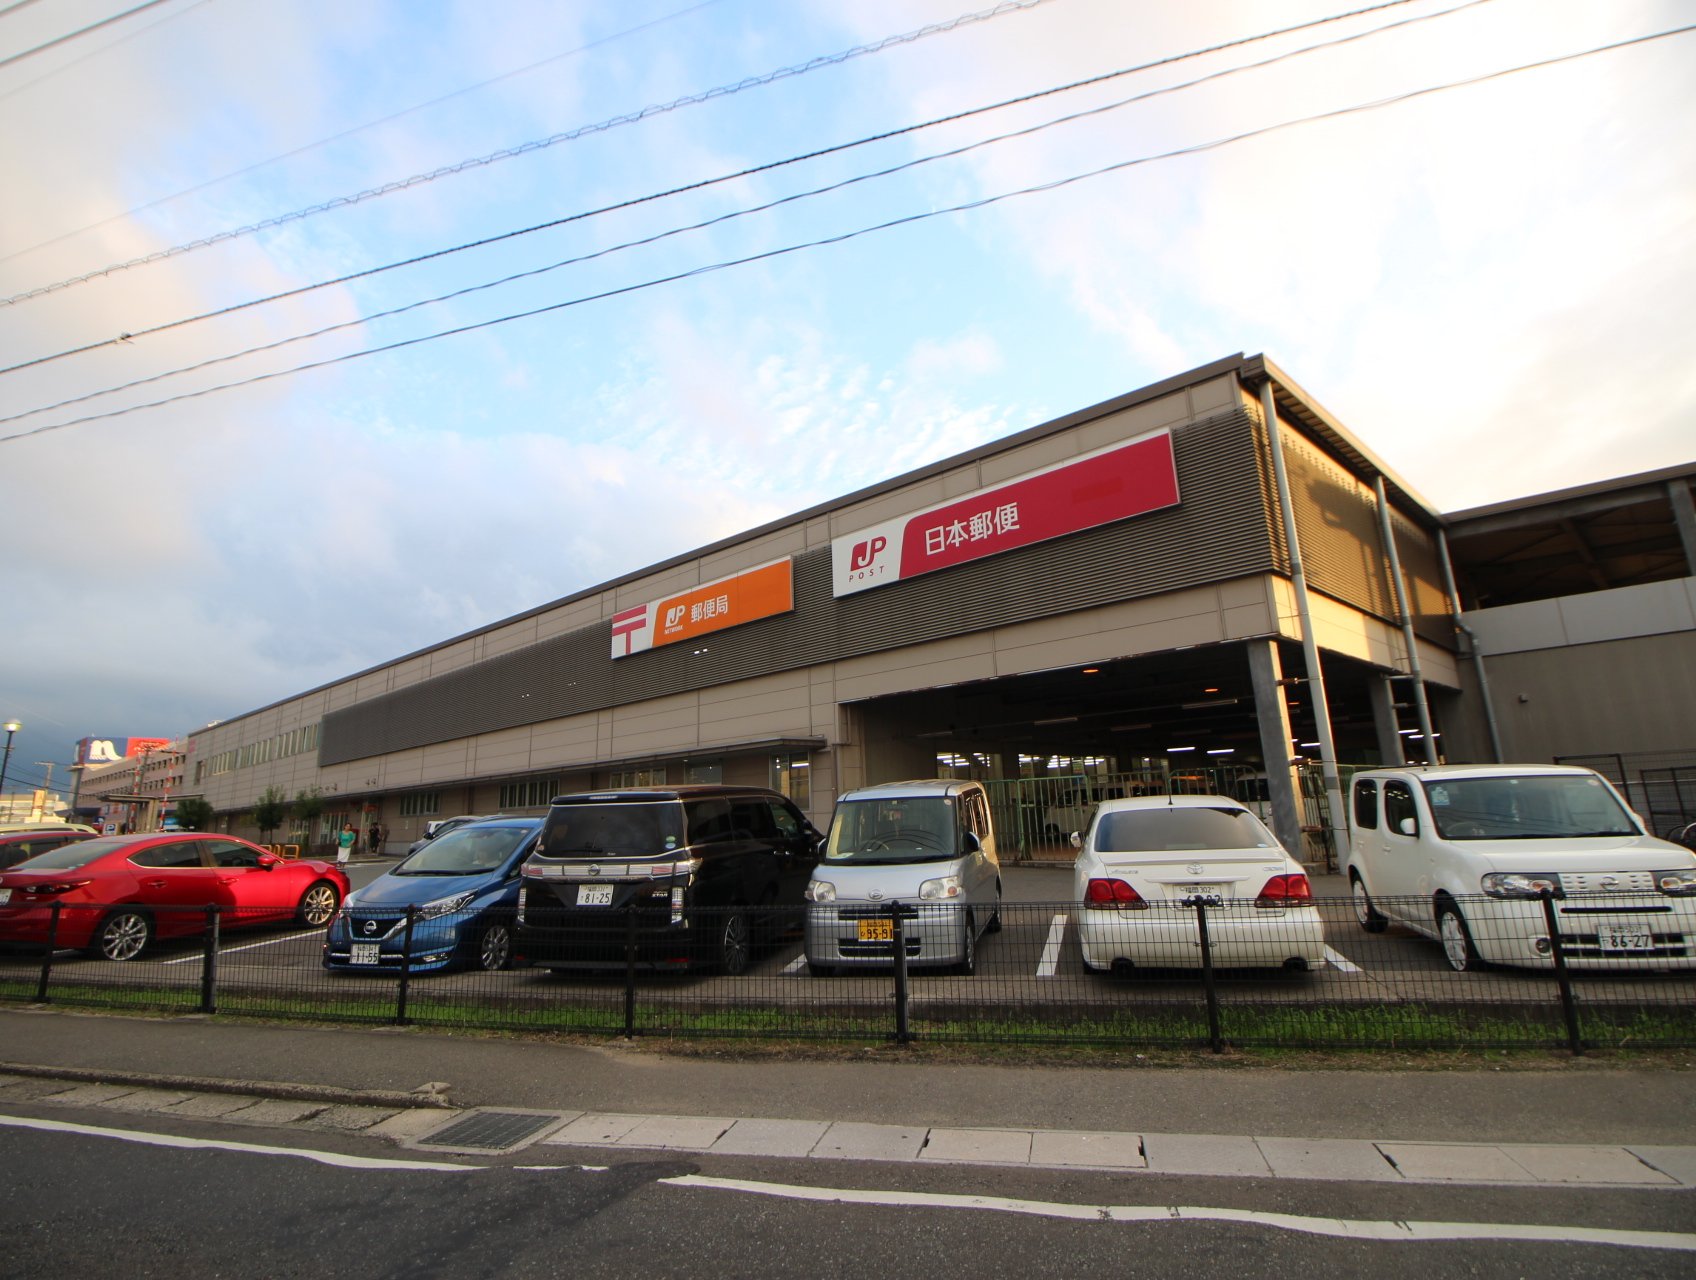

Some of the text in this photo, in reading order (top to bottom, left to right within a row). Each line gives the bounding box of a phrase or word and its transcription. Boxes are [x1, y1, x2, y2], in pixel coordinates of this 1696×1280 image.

[924, 501, 1020, 556] 日本郵便
[850, 535, 887, 572] JP
[848, 565, 886, 583] POST
[665, 604, 686, 628] JP
[690, 594, 729, 622] 郵便局
[584, 892, 610, 904] 81-25
[1199, 886, 1212, 894] 302
[1611, 934, 1649, 948] 86-27
